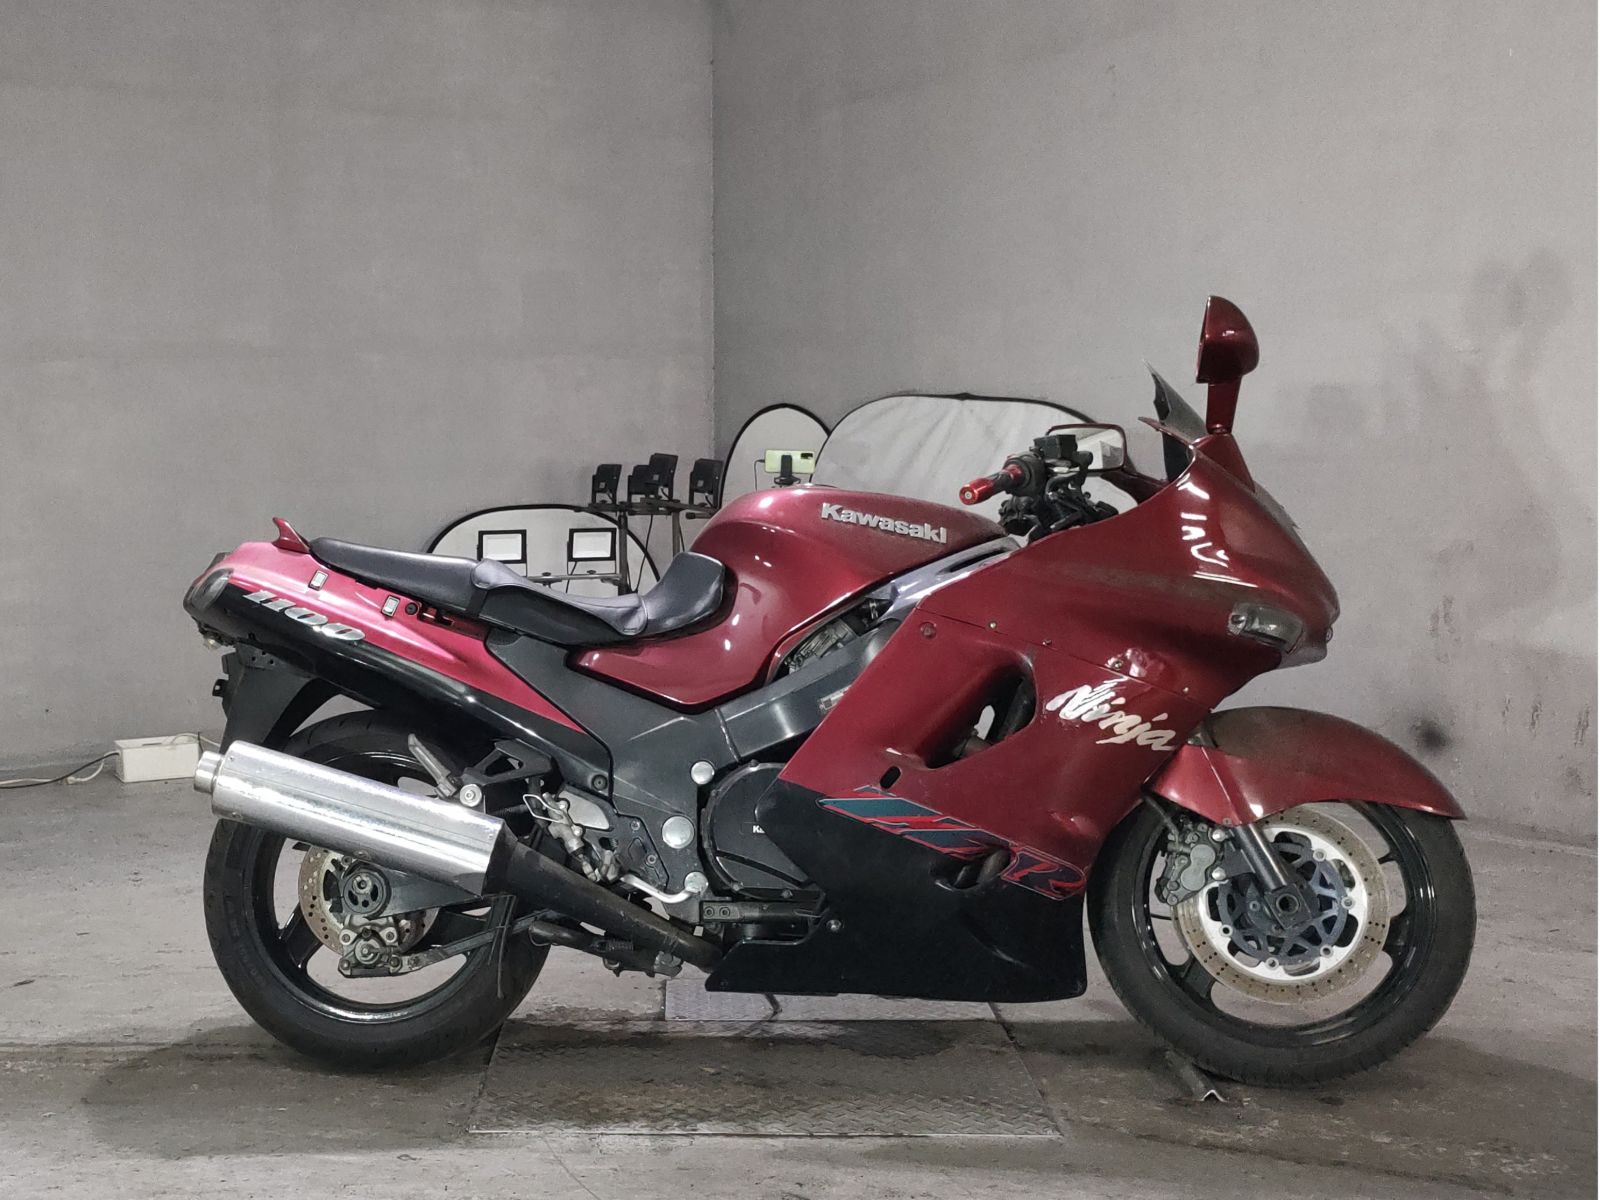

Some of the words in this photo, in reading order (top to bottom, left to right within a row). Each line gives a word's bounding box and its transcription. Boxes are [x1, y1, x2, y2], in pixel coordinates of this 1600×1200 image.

[821, 502, 947, 544] Kawasaki
[243, 589, 365, 640] 1100
[1045, 676, 1176, 751] Ninja
